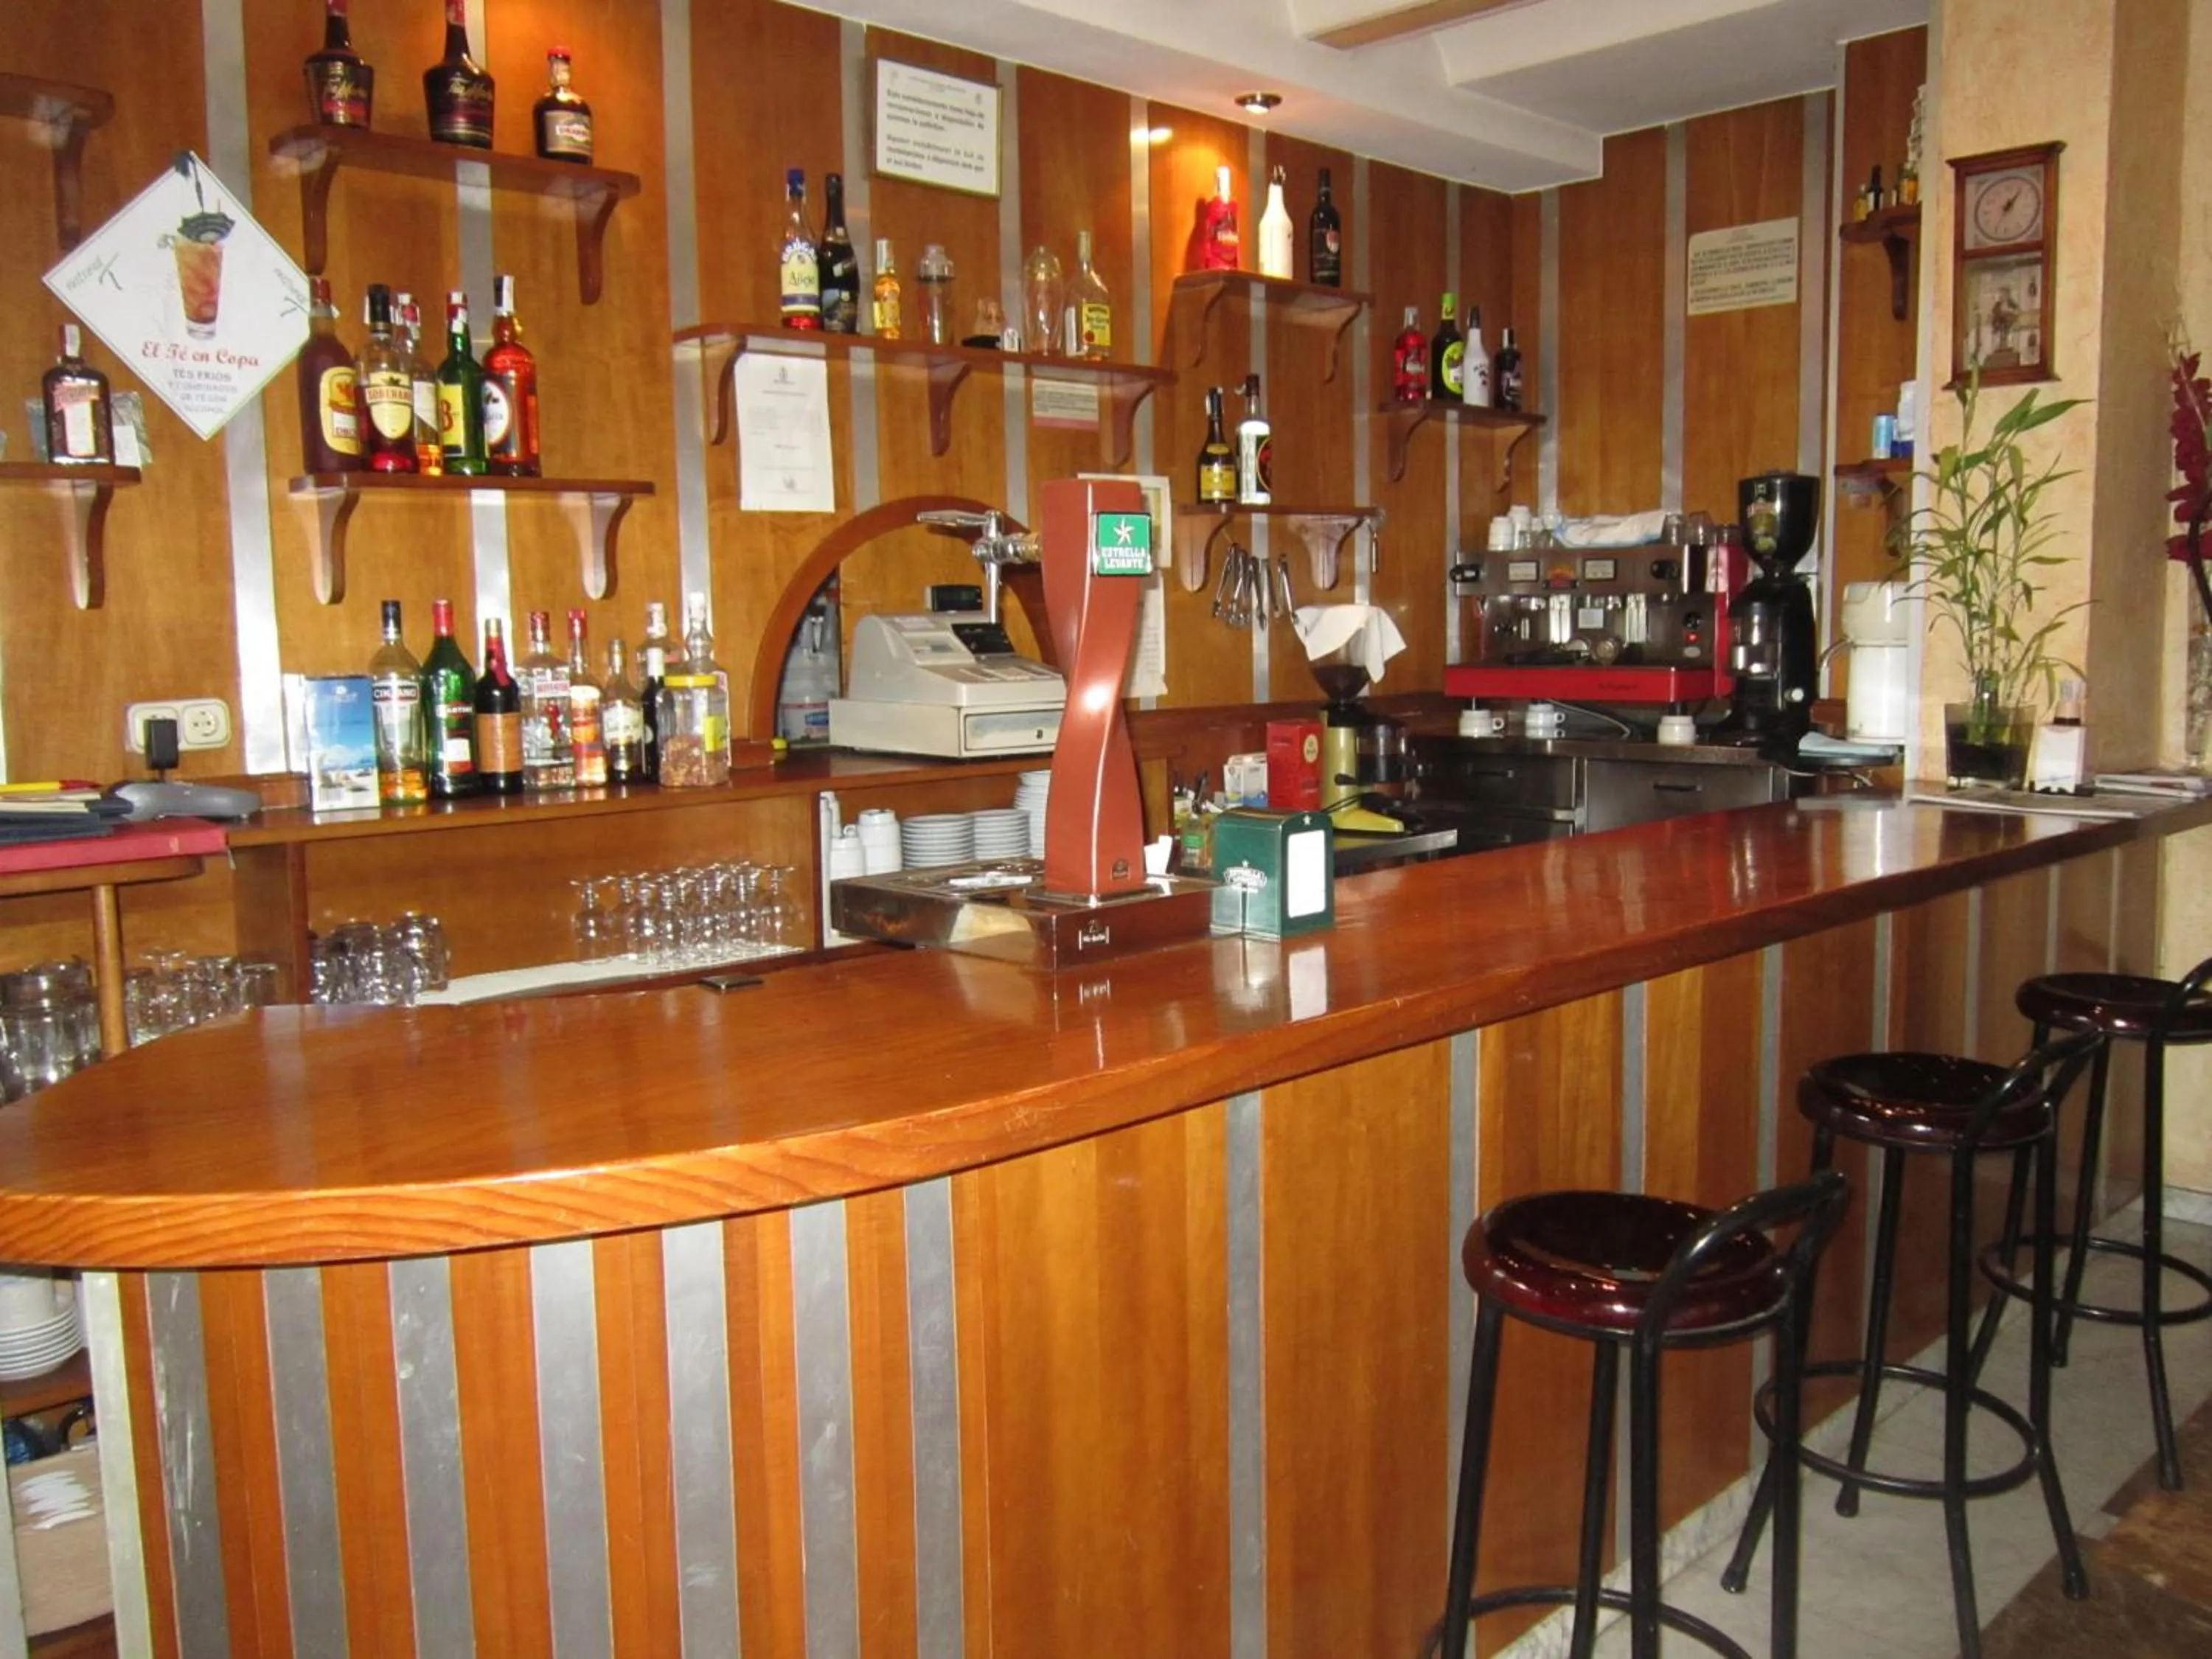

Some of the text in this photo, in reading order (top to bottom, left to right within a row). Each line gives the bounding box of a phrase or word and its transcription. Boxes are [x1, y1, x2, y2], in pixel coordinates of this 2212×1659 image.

[142, 341, 160, 358] El
[192, 350, 210, 362] en
[215, 347, 260, 369] Copa
[1102, 546, 1146, 558] ESTRELLA
[1105, 558, 1144, 569] LEVANTE
